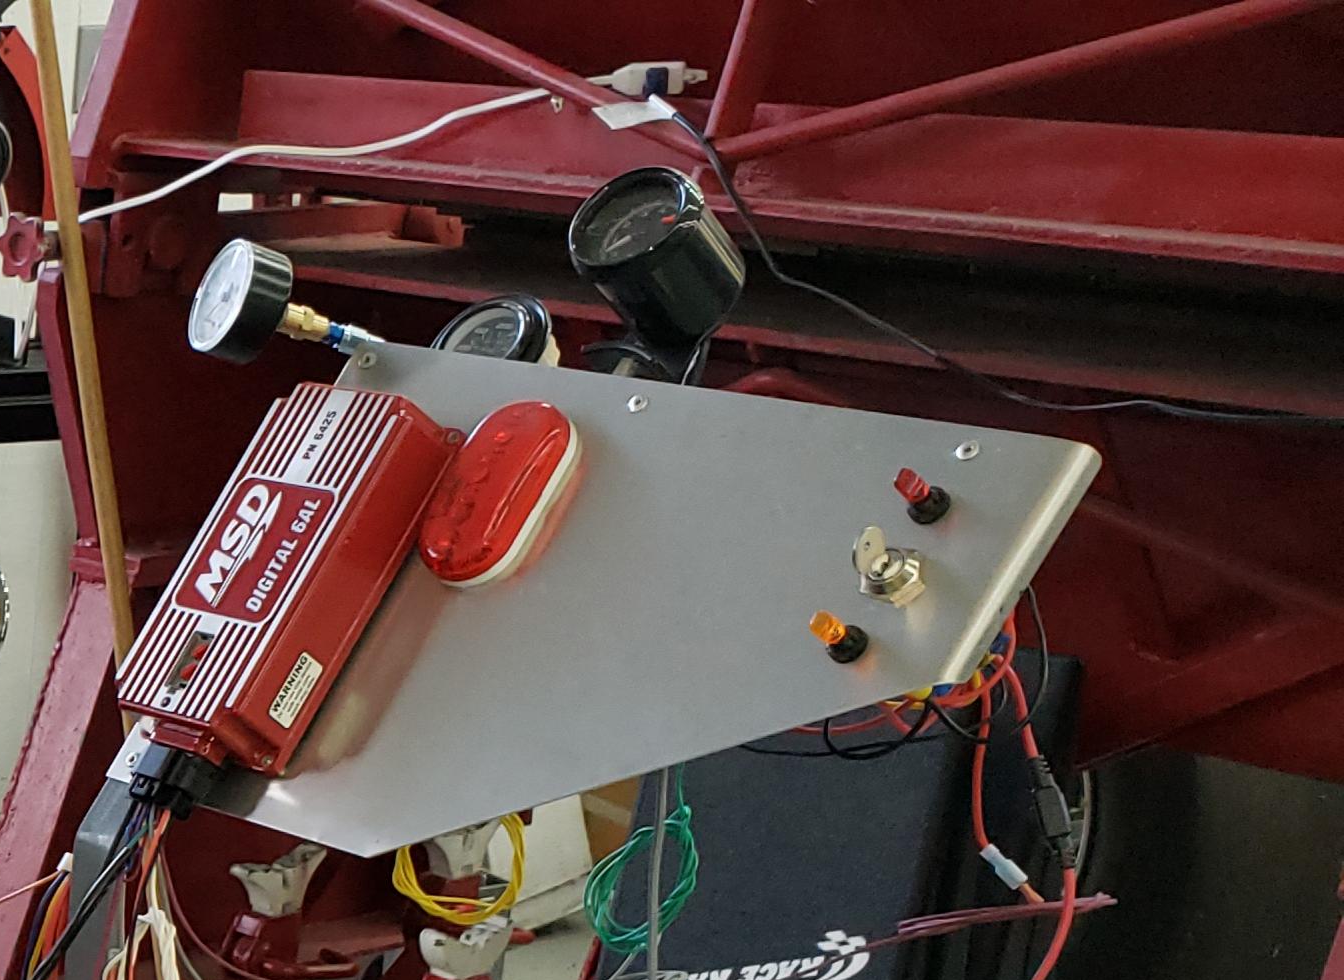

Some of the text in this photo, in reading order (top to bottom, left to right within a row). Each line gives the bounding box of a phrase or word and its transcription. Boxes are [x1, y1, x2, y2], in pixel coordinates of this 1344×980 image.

[302, 410, 338, 461] PN 6425
[194, 483, 279, 608] MSD
[245, 498, 321, 613] DIGITAL 6AL
[272, 655, 308, 712] WARNING
